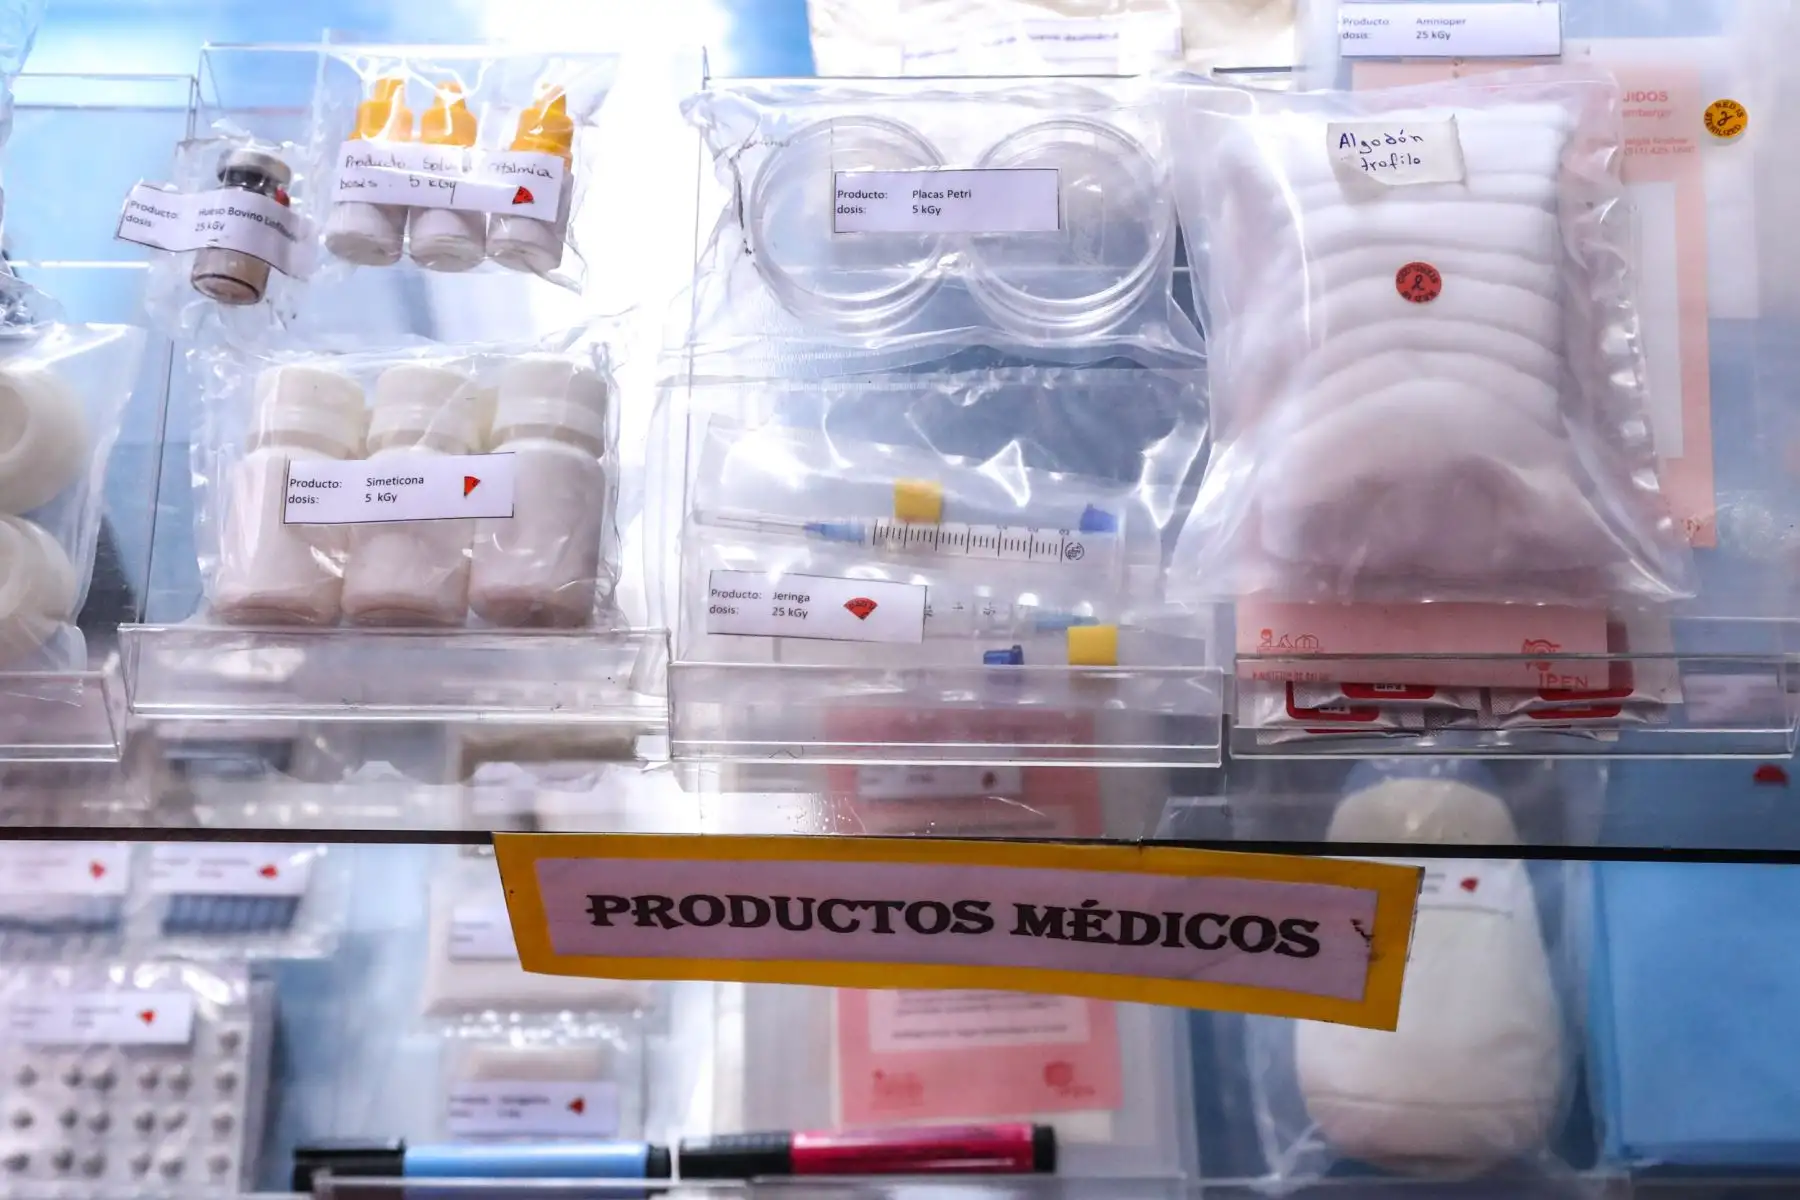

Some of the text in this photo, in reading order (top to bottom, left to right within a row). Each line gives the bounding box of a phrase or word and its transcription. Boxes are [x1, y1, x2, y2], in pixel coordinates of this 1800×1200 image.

[1415, 17, 1466, 28] Amnioper
[1416, 31, 1429, 39] 25
[1431, 30, 1451, 41] kGy
[1339, 129, 1424, 154] Algodón
[409, 174, 420, 188] 5
[837, 189, 972, 200] Producto: Placas Petri
[198, 207, 225, 217] Hueso
[228, 206, 263, 223] Bovino
[836, 204, 942, 216] dosis: 5 kGy
[289, 475, 424, 489] Producto: Simeticona
[288, 492, 398, 505] dosis: 5 kGy
[711, 588, 811, 604] Producto: Jeringa
[709, 604, 809, 620] dosis: 25 kGy
[1538, 673, 1589, 689] IPEN
[586, 894, 1321, 959] PRODUCTOS MÉDICOS
